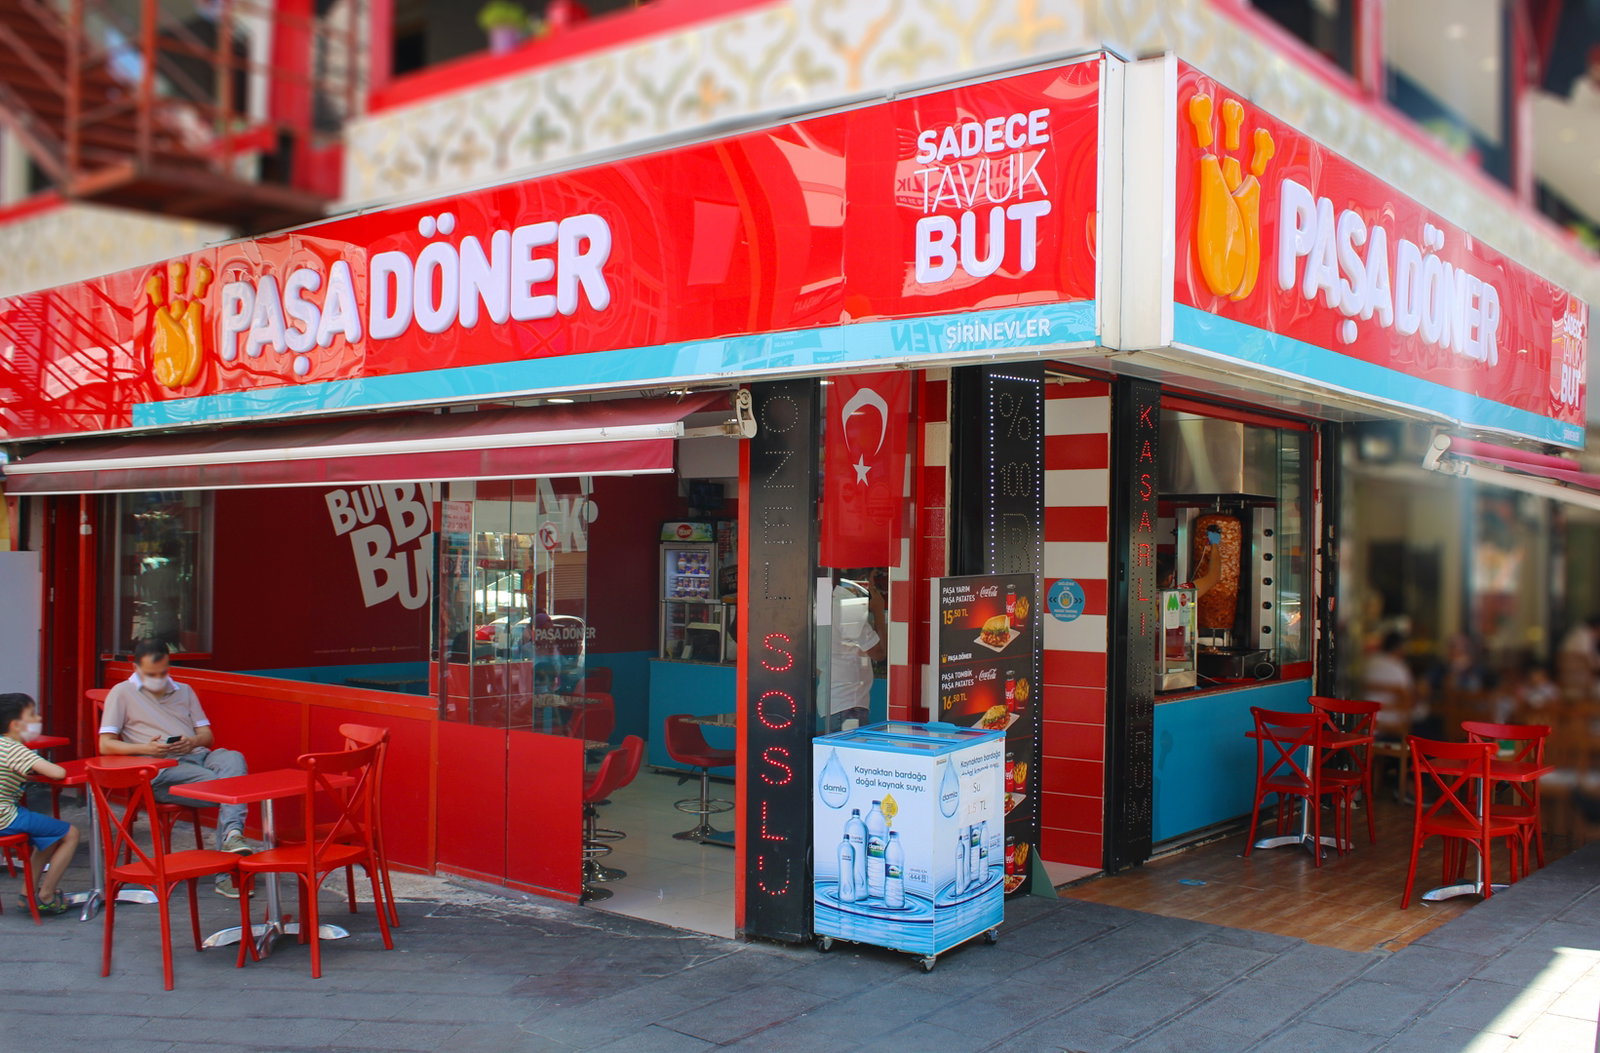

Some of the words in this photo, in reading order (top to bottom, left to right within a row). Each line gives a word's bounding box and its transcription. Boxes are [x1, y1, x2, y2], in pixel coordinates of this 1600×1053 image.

[916, 108, 1050, 164] SADECE
[914, 148, 1048, 213] TAVUK
[915, 200, 1051, 284] BUT
[1278, 178, 1393, 344] PAŞA
[1395, 222, 1499, 367] DÖNER
[221, 260, 362, 375] PAŞA
[369, 212, 611, 339] DÖNER
[946, 318, 1050, 348] ŞİRİNEVLER
[1560, 363, 1580, 408] BUT
[956, 594, 975, 603] PATATES
[955, 679, 974, 688] PATATES
[823, 784, 847, 793] damla
[855, 766, 893, 777] Kaynaktan
[894, 769, 927, 782] bardağa
[856, 777, 876, 788] doğal
[877, 779, 904, 790] kaynak
